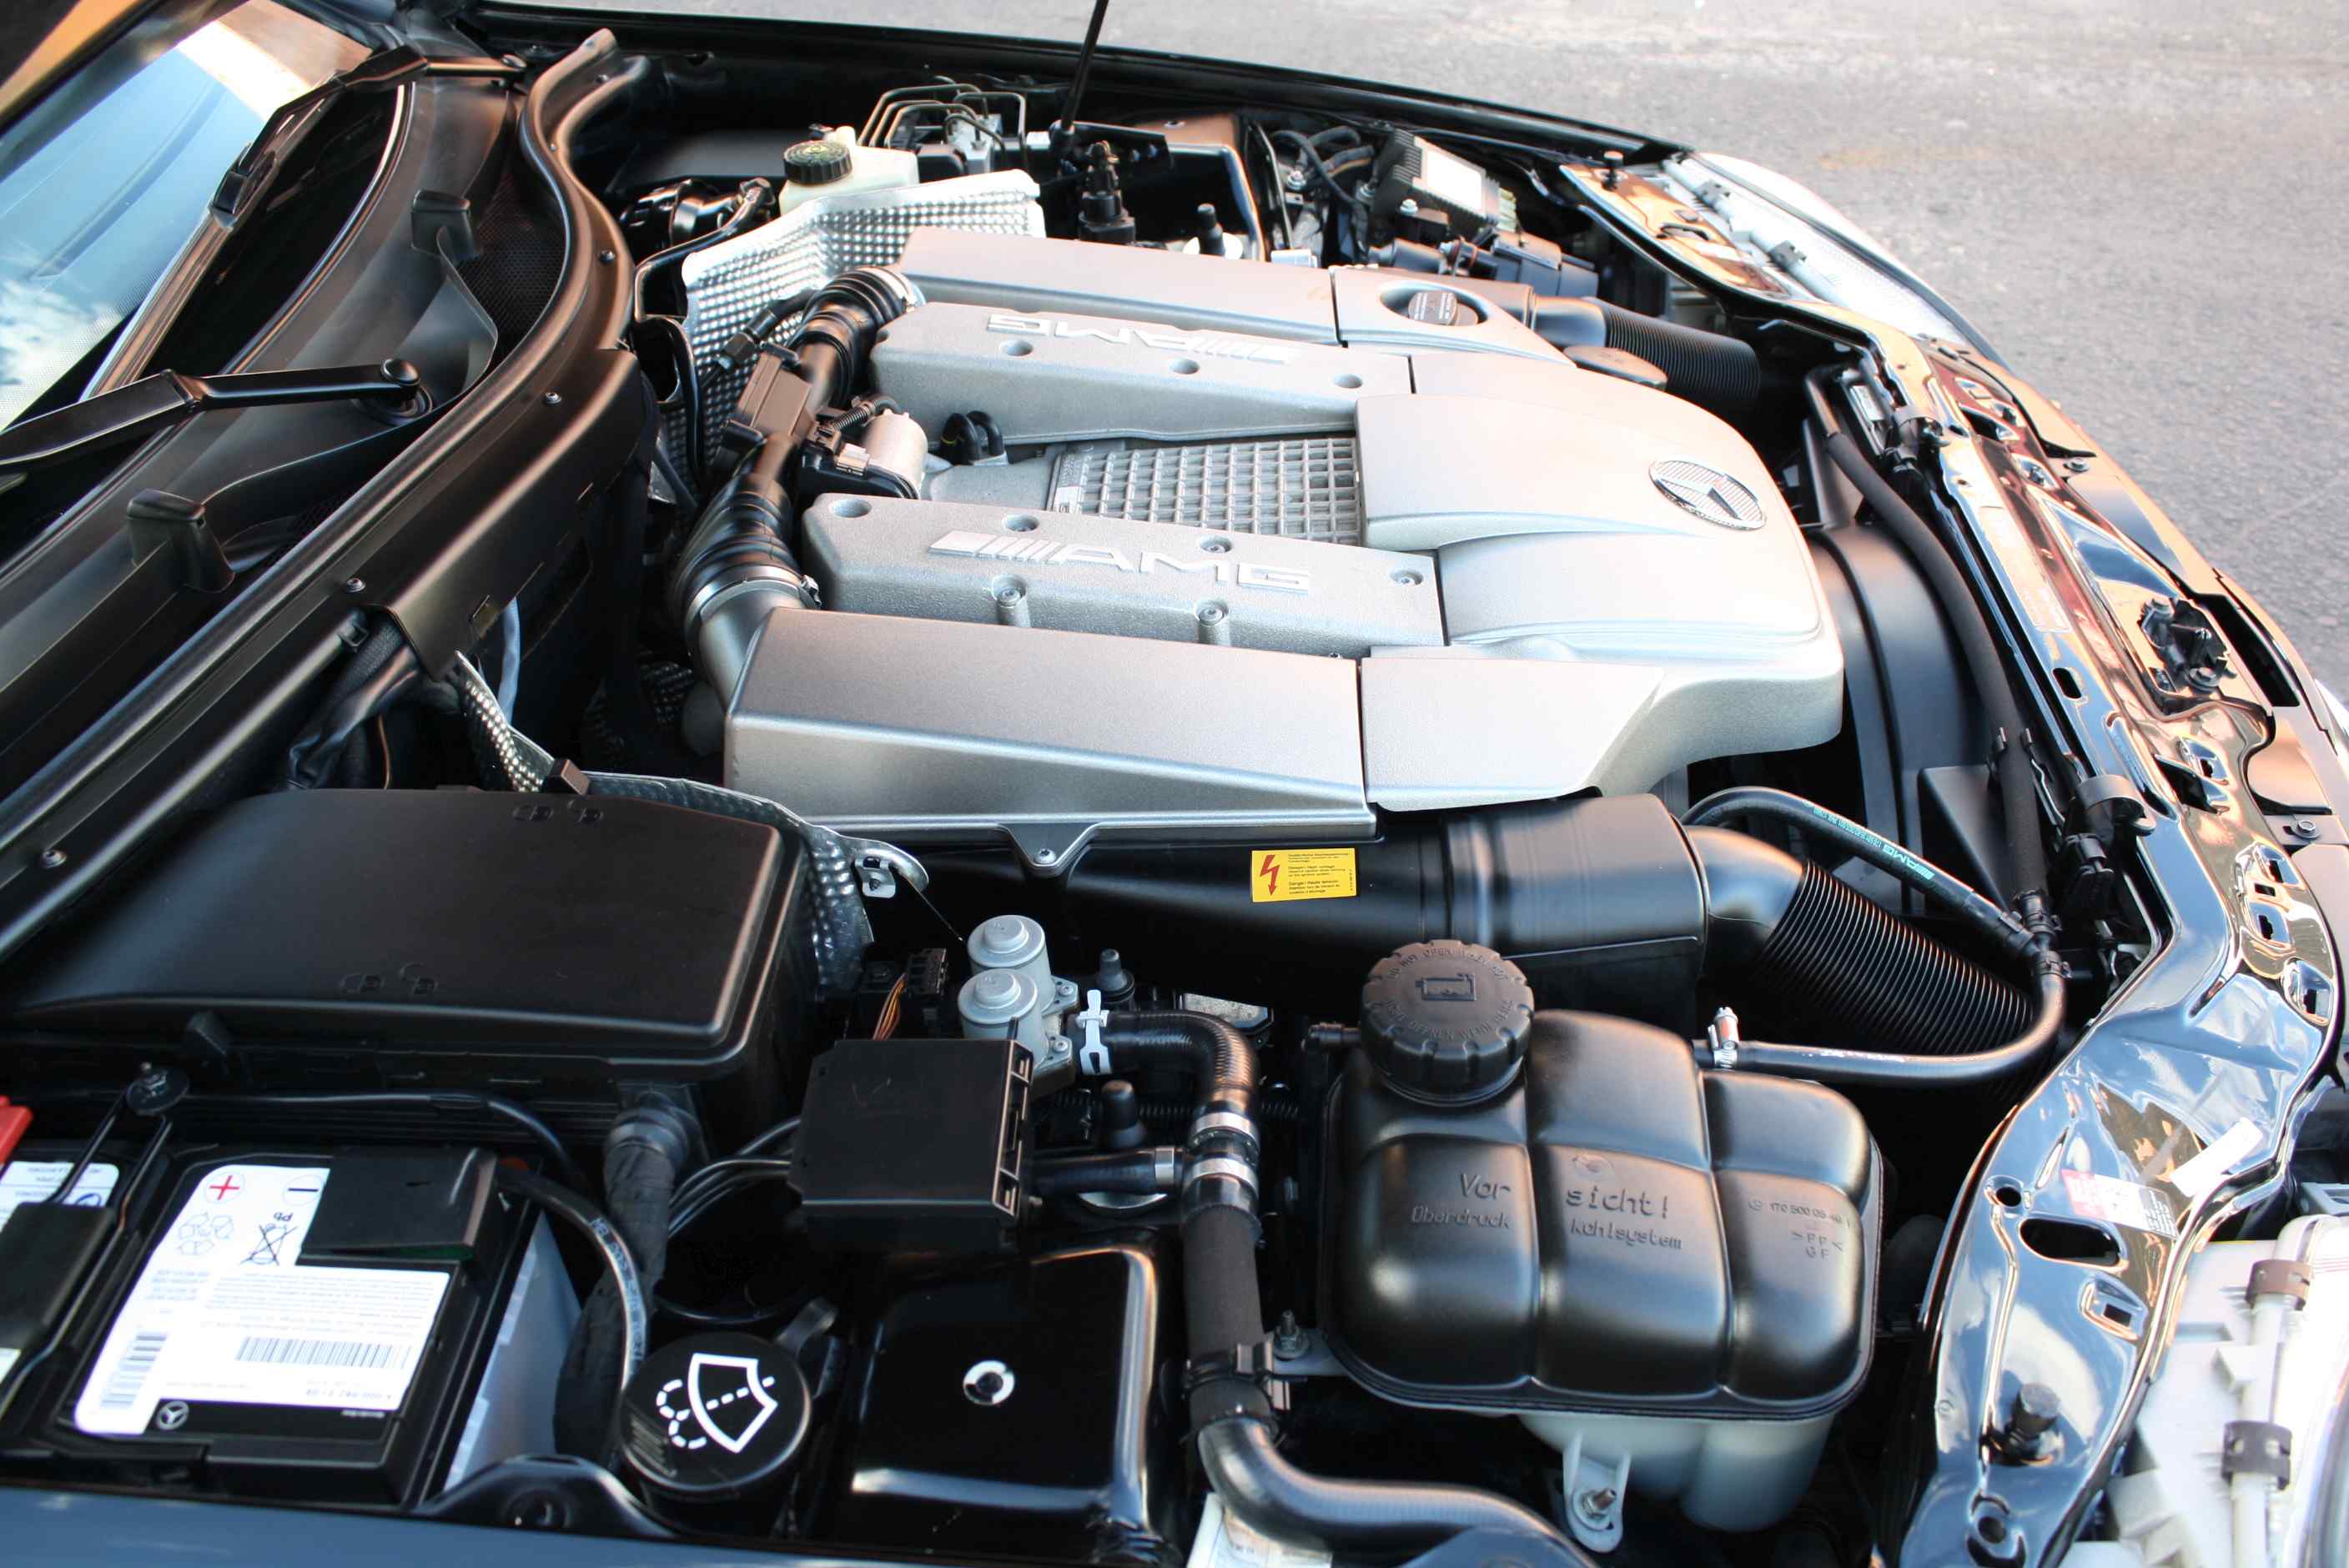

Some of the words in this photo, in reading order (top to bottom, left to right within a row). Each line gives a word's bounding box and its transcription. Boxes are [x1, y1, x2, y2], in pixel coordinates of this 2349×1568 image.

[1044, 542, 1309, 595] AMG
[1882, 843, 1924, 872] AMG
[1461, 1173, 1511, 1199] Vor
[1566, 1184, 1668, 1219] sicht!
